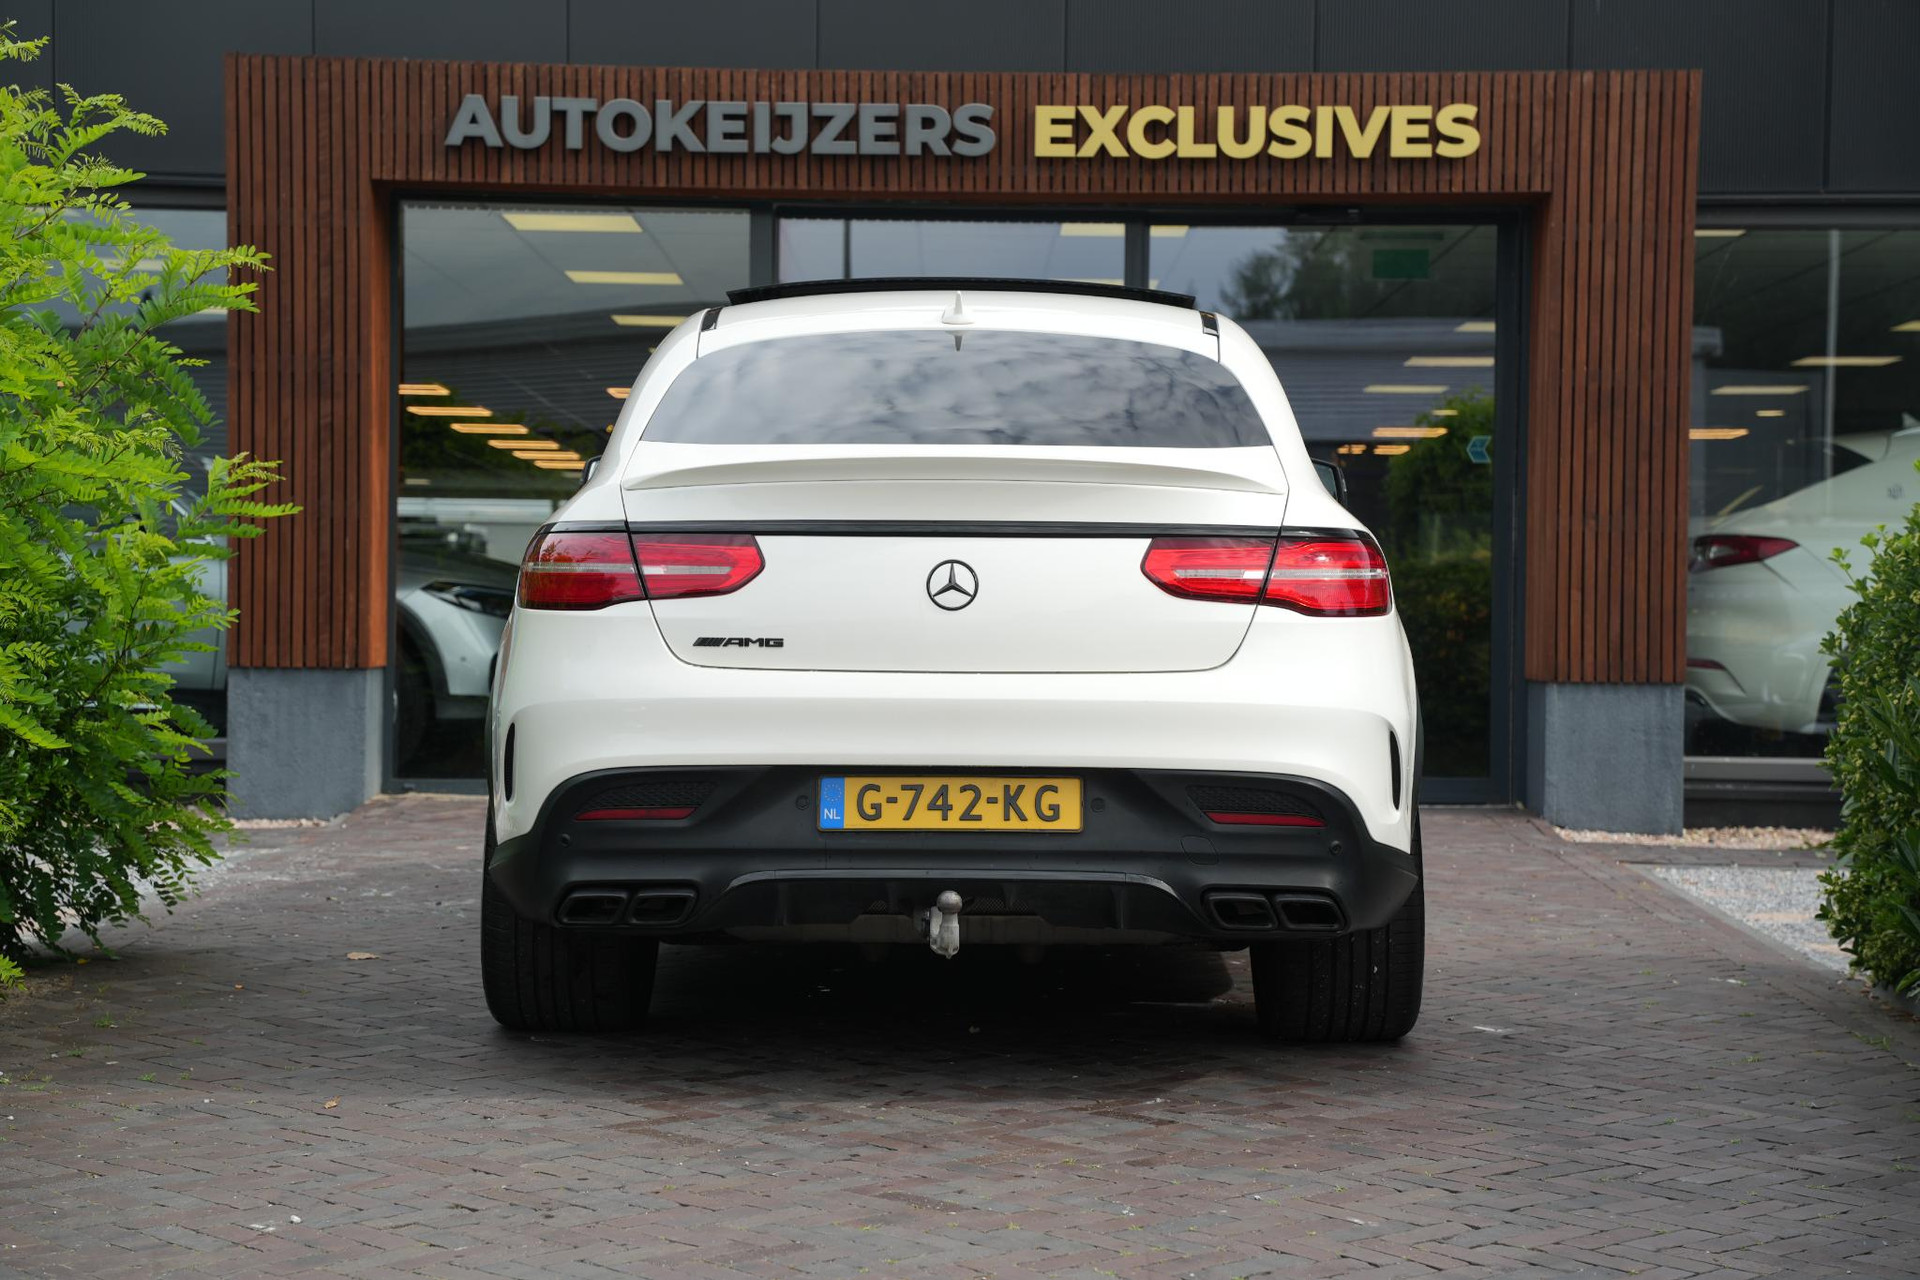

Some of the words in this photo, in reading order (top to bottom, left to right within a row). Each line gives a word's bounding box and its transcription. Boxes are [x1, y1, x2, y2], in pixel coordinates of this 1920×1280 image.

[444, 94, 996, 157] AUTOKEIJZERS
[1034, 103, 1481, 159] EXCLUSIVES
[722, 637, 784, 648] AMG
[823, 808, 841, 820] NL
[856, 783, 1060, 822] G-742-KG
